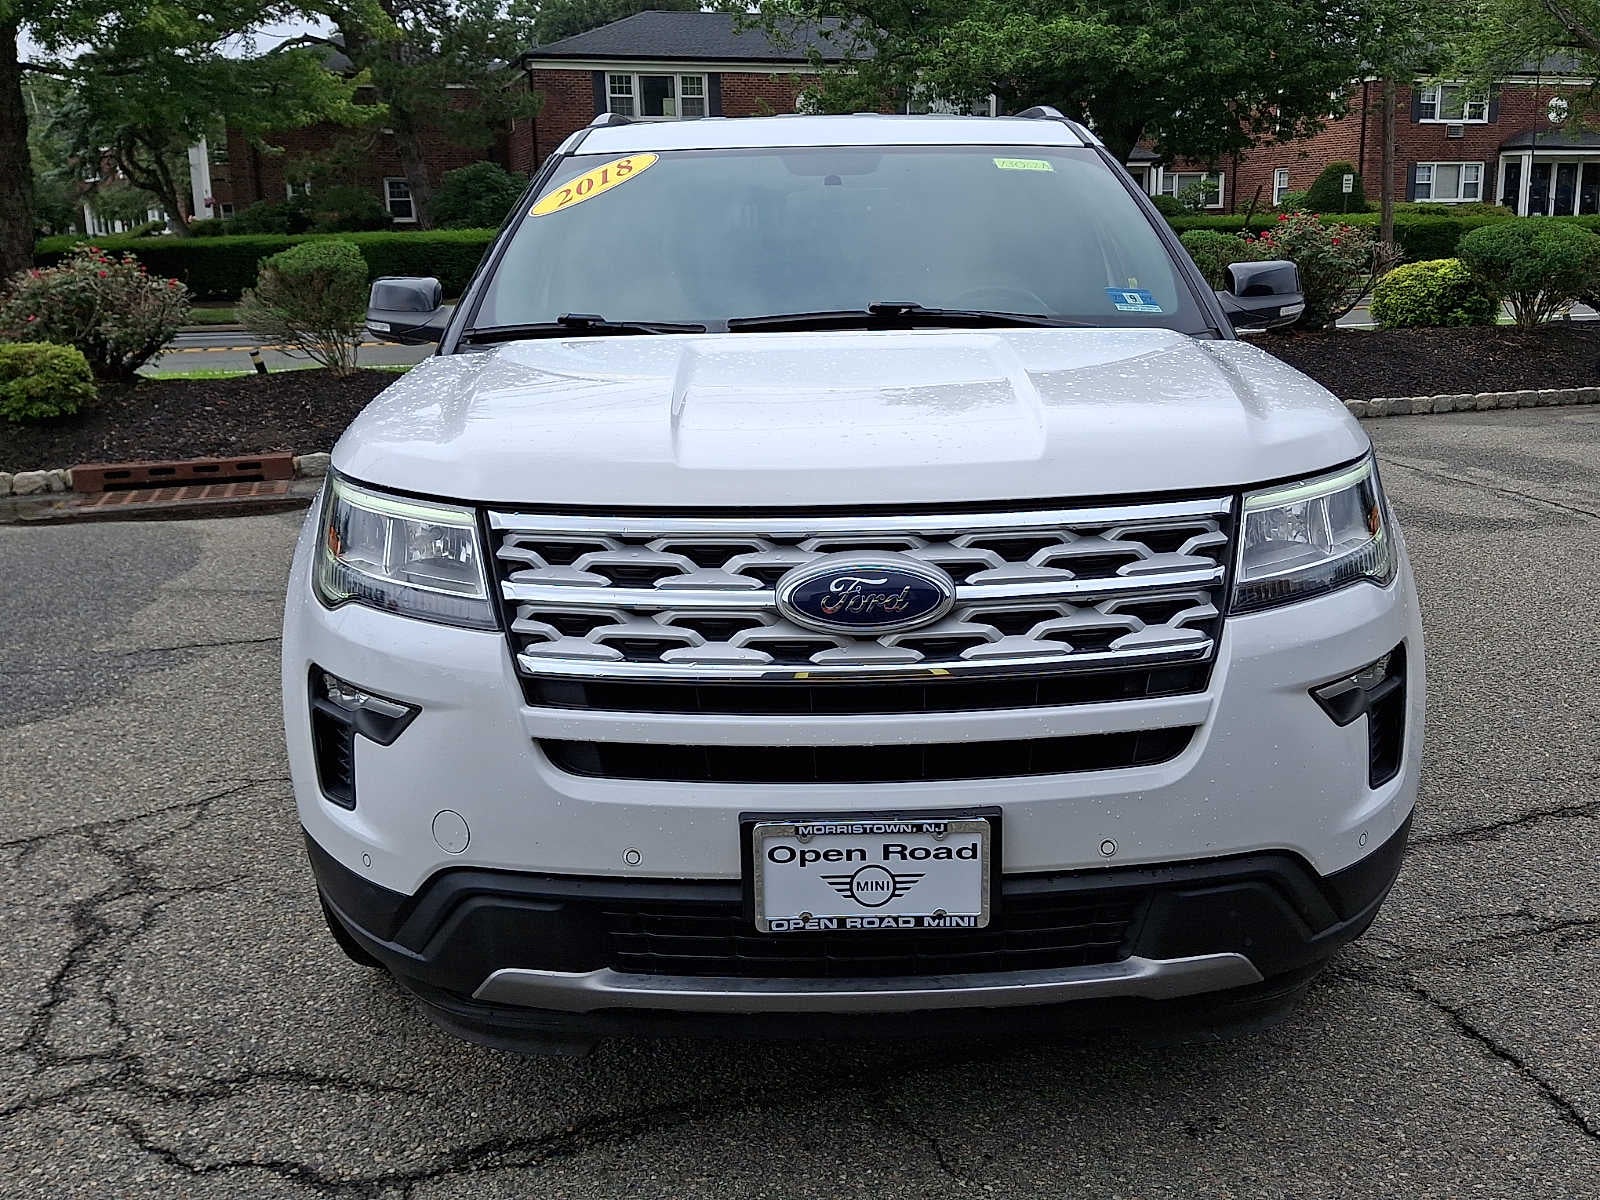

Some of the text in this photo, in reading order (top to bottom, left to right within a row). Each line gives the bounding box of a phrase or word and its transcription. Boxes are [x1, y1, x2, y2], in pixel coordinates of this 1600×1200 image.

[557, 159, 633, 207] 2018
[820, 576, 911, 614] Ford
[798, 823, 946, 835] MORRISTOWN, NJ
[767, 842, 978, 868] Open Road
[856, 881, 890, 892] MINI
[771, 916, 976, 931] OPEN ROAD MINI
